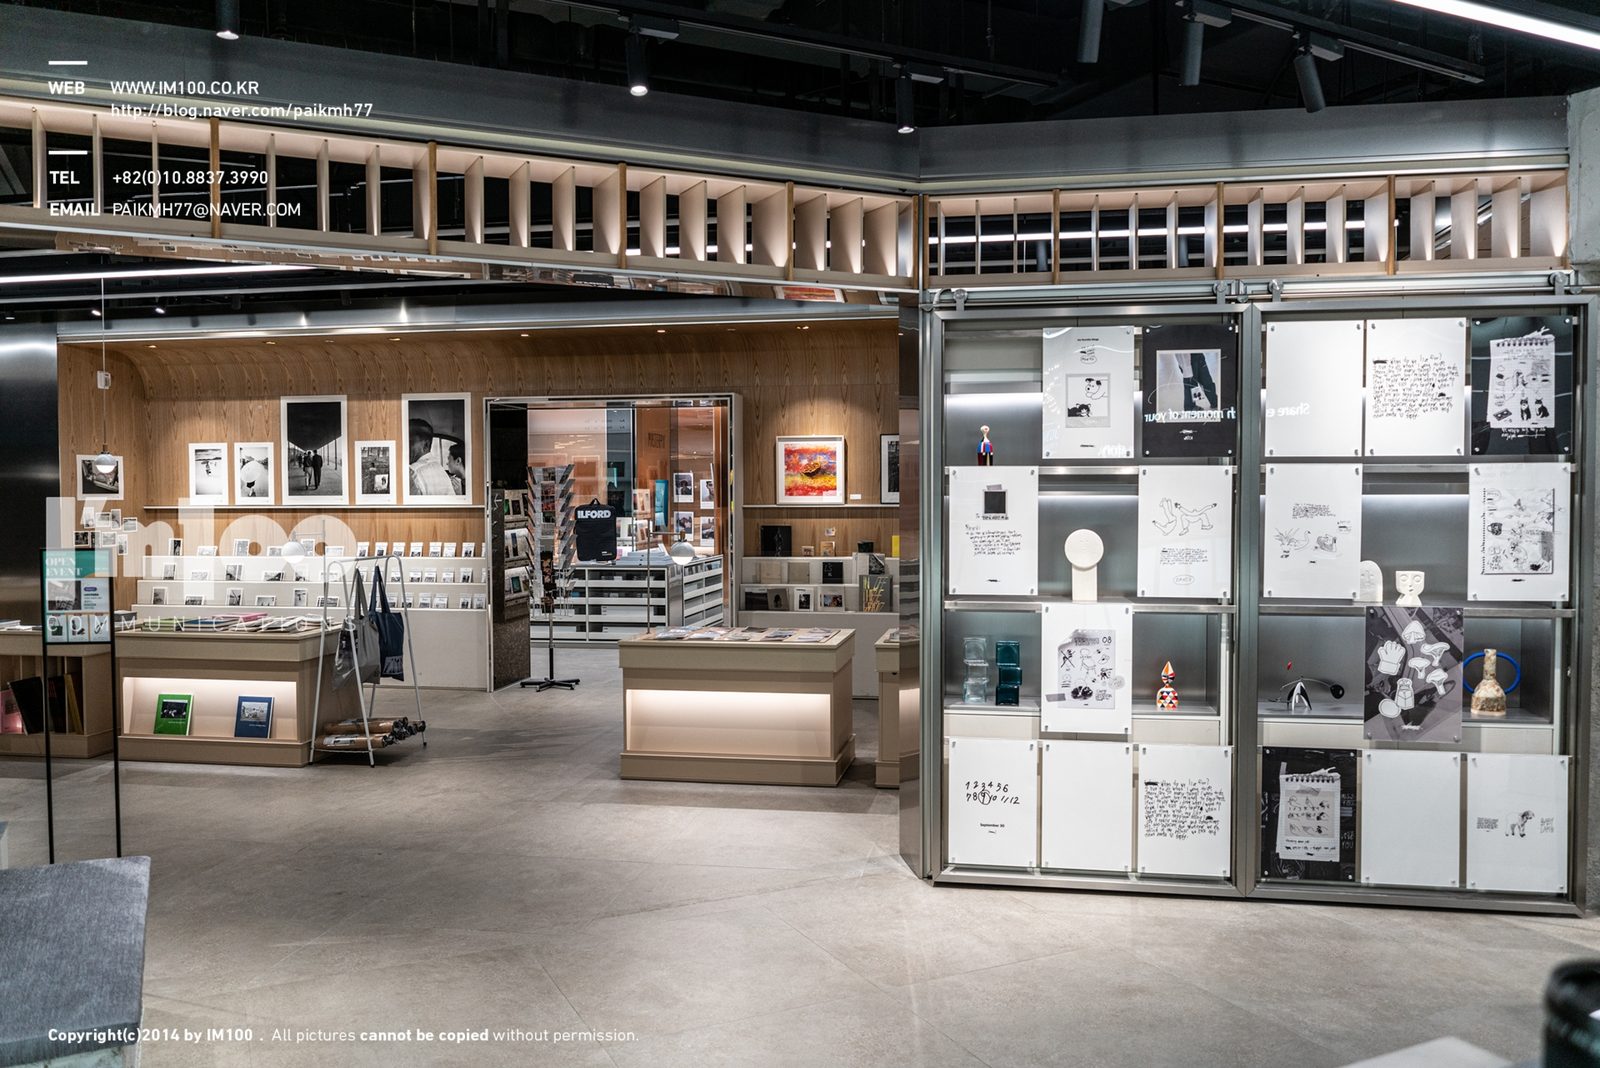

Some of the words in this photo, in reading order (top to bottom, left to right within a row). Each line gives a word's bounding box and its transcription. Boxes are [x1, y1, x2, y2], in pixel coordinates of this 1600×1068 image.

[577, 510, 611, 518] ILFORD
[965, 781, 970, 790] 1
[973, 781, 978, 789] 2
[981, 782, 986, 792] 3
[996, 783, 1002, 792] 5
[1003, 784, 1009, 793] 6
[966, 793, 972, 802] 7
[972, 792, 978, 801] 8
